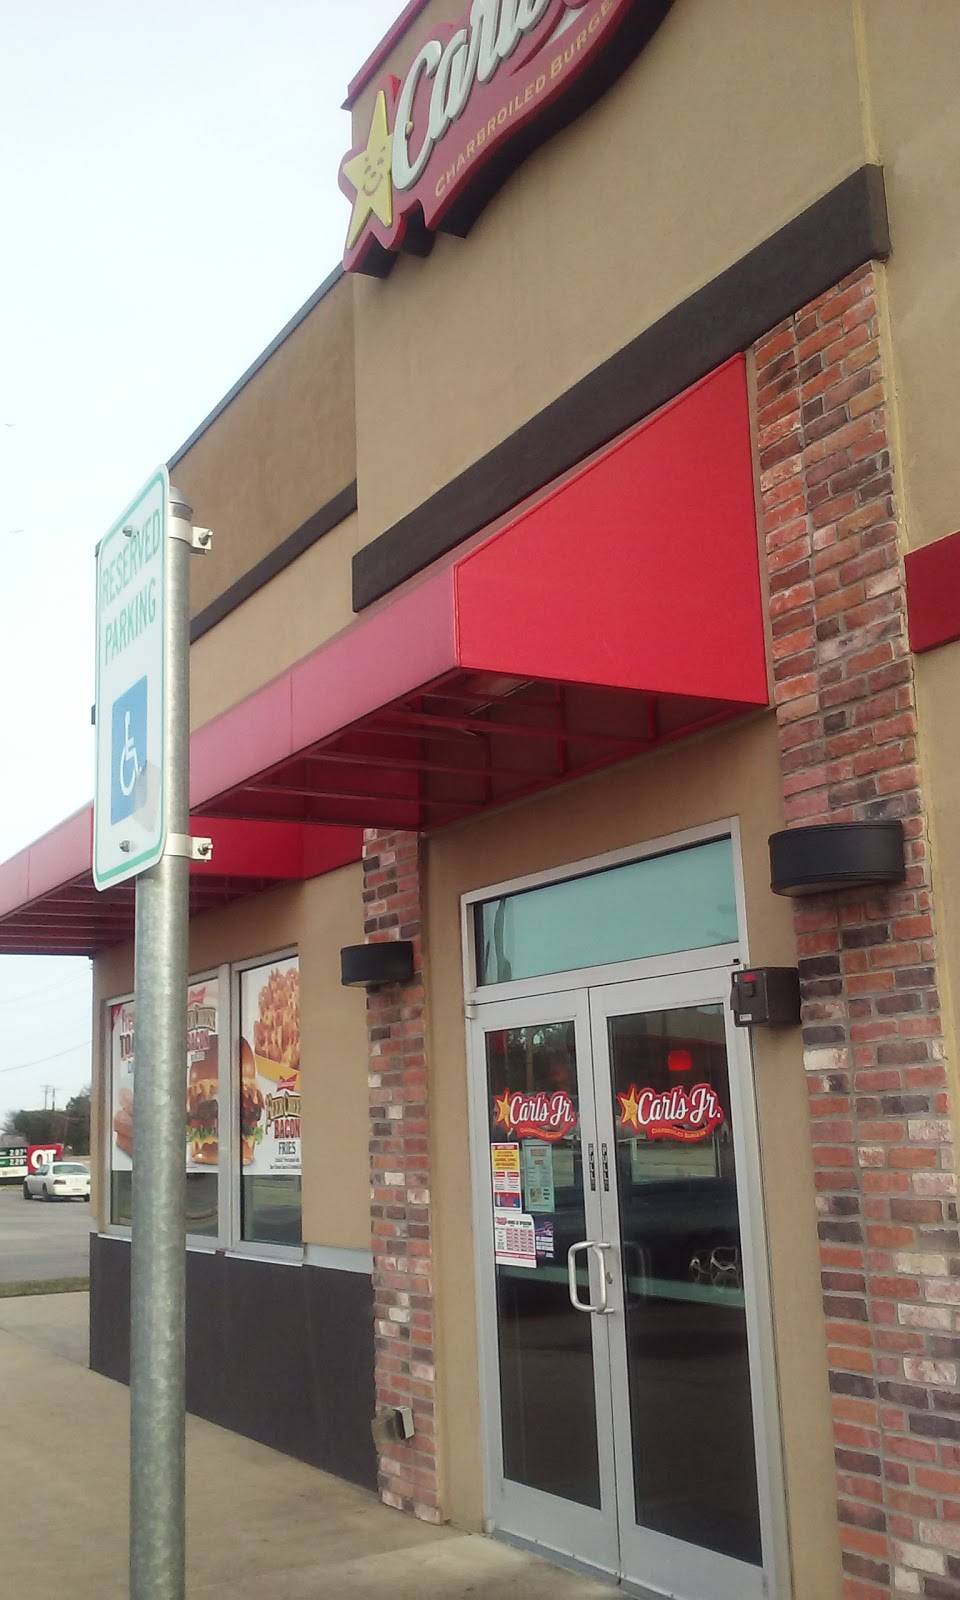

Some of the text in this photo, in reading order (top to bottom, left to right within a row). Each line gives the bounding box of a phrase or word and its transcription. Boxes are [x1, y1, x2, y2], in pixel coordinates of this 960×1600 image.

[435, 73, 546, 199] CHARBROILED
[102, 508, 160, 604] RESERVED
[105, 576, 156, 665] PARKING
[509, 1093, 574, 1126] Carl's Jr.
[637, 1086, 721, 1125] Carl's Jr.
[274, 1119, 300, 1139] BACON
[31, 1149, 57, 1169] QT
[278, 1141, 296, 1155] FRIES
